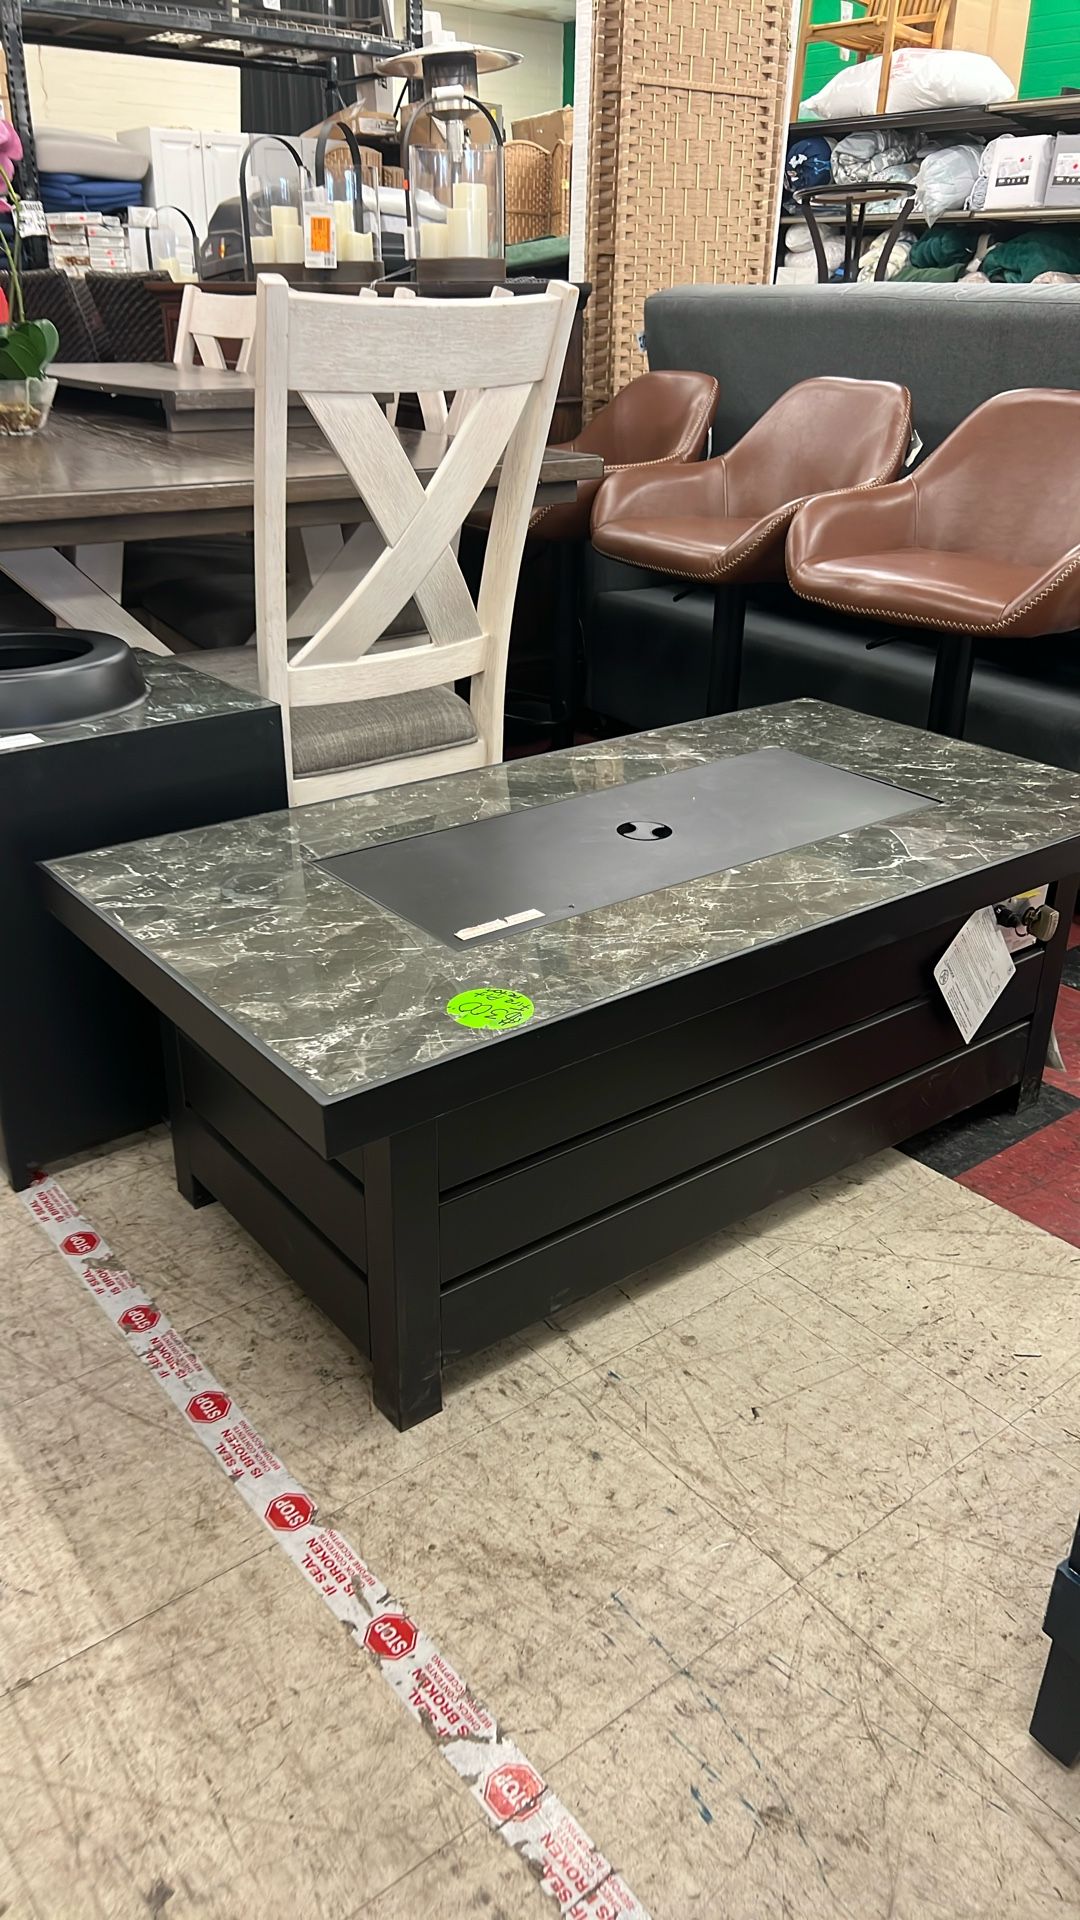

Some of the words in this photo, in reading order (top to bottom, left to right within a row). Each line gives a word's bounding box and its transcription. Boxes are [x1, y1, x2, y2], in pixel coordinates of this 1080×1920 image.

[69, 1235, 92, 1253] STOP
[127, 1309, 151, 1330] STOP
[194, 1396, 222, 1420] STOP
[215, 1442, 237, 1468] SEAL
[220, 1428, 256, 1468] BROKEN
[231, 1466, 245, 1477] IF
[250, 1466, 264, 1479] IS
[274, 1499, 305, 1528] STOP
[305, 1537, 348, 1584] BROKEN
[318, 1533, 347, 1567] CONTENTS
[301, 1553, 327, 1584] SEAL
[346, 1564, 366, 1589] CCK
[321, 1583, 338, 1597] IF
[343, 1582, 356, 1597] IS
[373, 1621, 409, 1655] STOP
[456, 1723, 470, 1738] S
[539, 1832, 598, 1905] ROKEN
